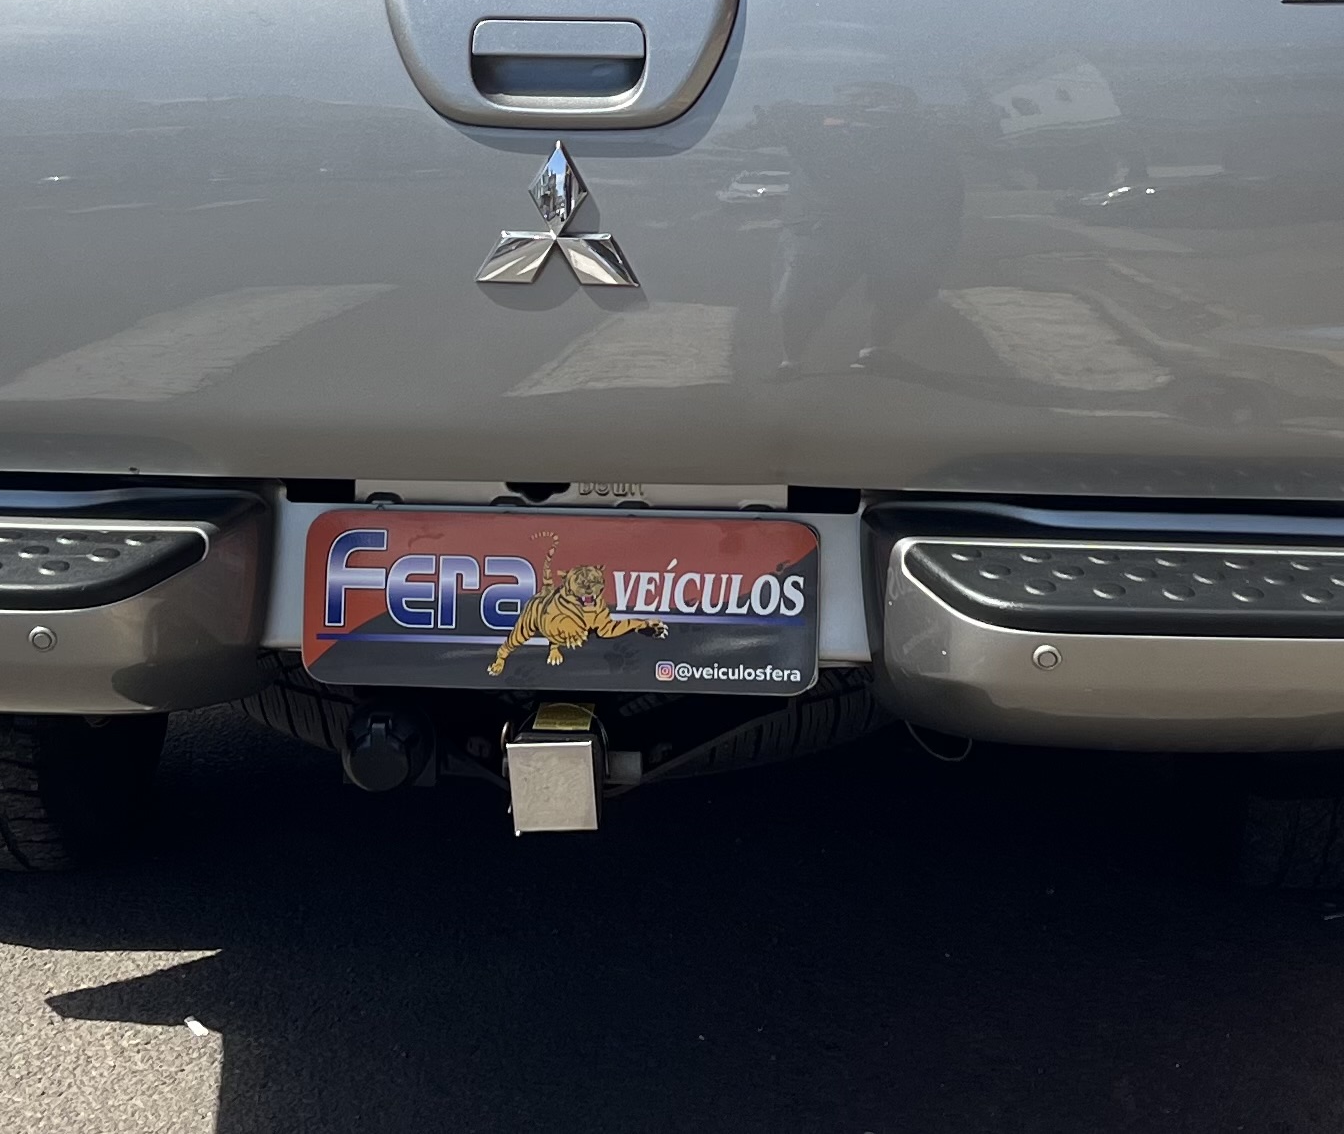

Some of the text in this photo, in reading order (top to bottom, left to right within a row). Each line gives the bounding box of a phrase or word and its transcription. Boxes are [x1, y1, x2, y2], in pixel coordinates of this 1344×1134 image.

[324, 528, 806, 630] Fera VEÍCULOS
[675, 664, 802, 683] @veiculosfera
